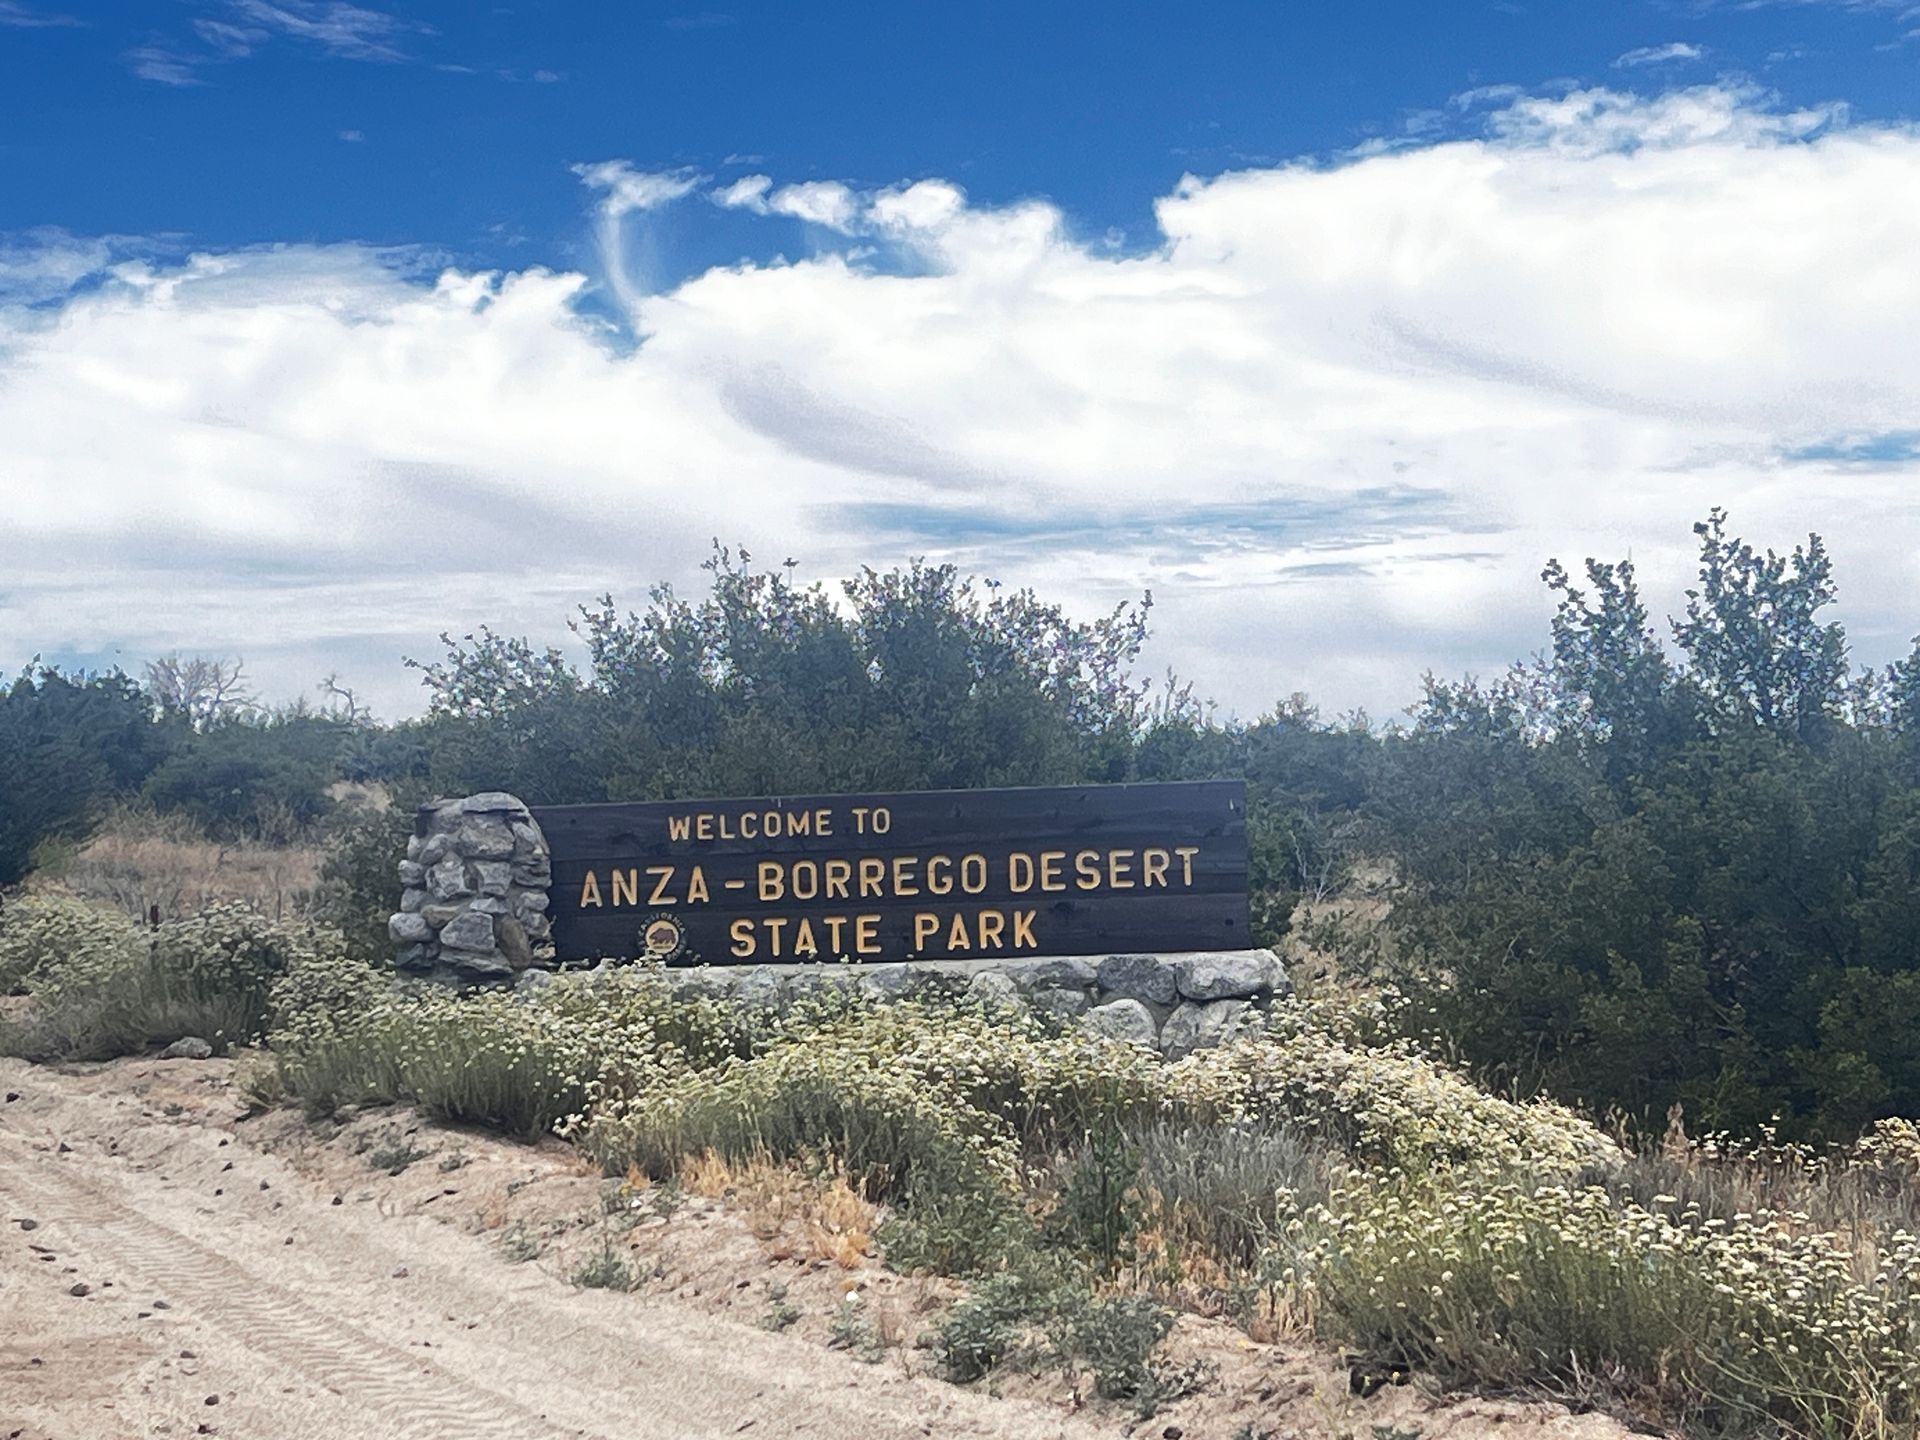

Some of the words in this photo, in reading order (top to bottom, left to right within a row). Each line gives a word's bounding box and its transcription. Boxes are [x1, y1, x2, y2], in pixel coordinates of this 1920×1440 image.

[669, 810, 832, 841] WELCOME
[852, 808, 892, 835] TO
[1009, 847, 1198, 893] DESERT
[730, 915, 882, 958] STATE
[914, 910, 1038, 952] PARK
